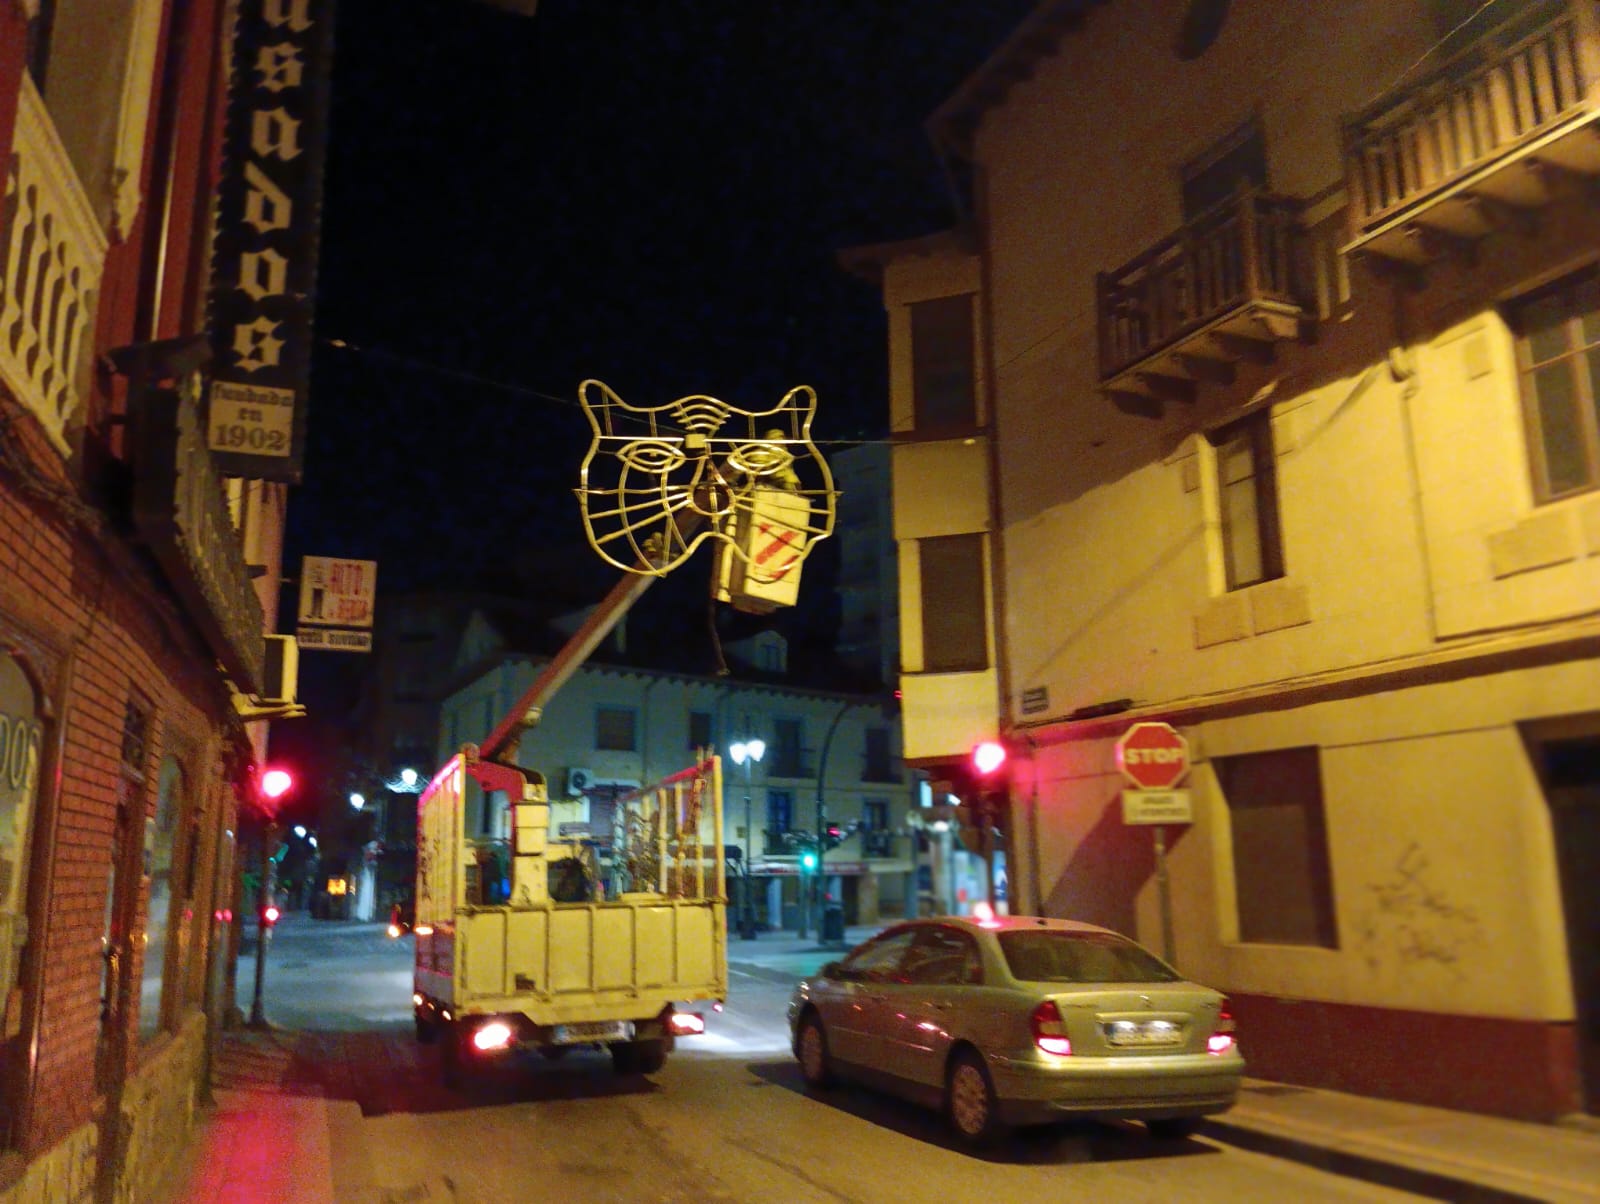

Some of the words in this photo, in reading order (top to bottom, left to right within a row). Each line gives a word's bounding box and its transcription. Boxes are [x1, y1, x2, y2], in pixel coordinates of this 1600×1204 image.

[239, 408, 262, 422] en
[216, 425, 286, 451] 1902
[1126, 748, 1183, 765] STOP
